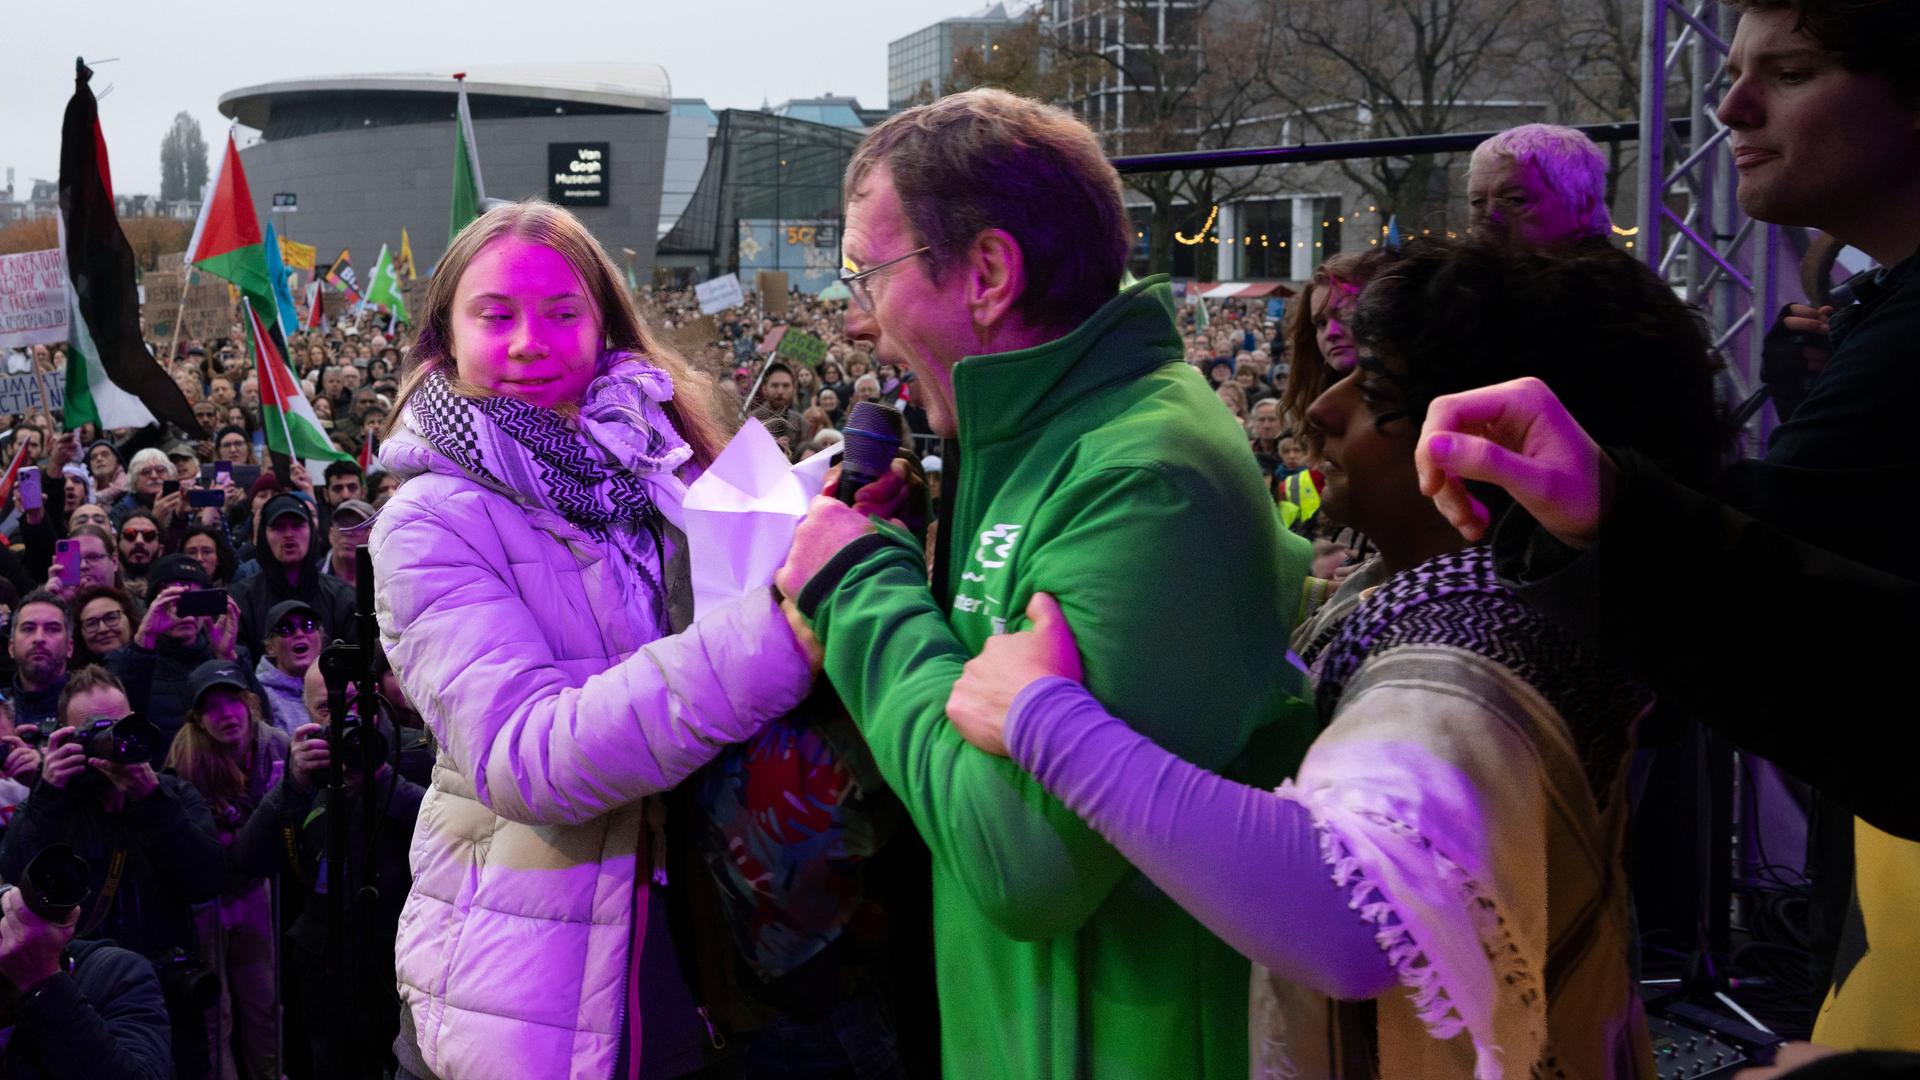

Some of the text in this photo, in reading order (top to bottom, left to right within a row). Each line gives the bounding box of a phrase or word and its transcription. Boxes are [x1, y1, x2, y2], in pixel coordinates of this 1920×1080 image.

[578, 149, 602, 160] Van
[570, 160, 602, 173] Gogh
[555, 173, 602, 184] Museum
